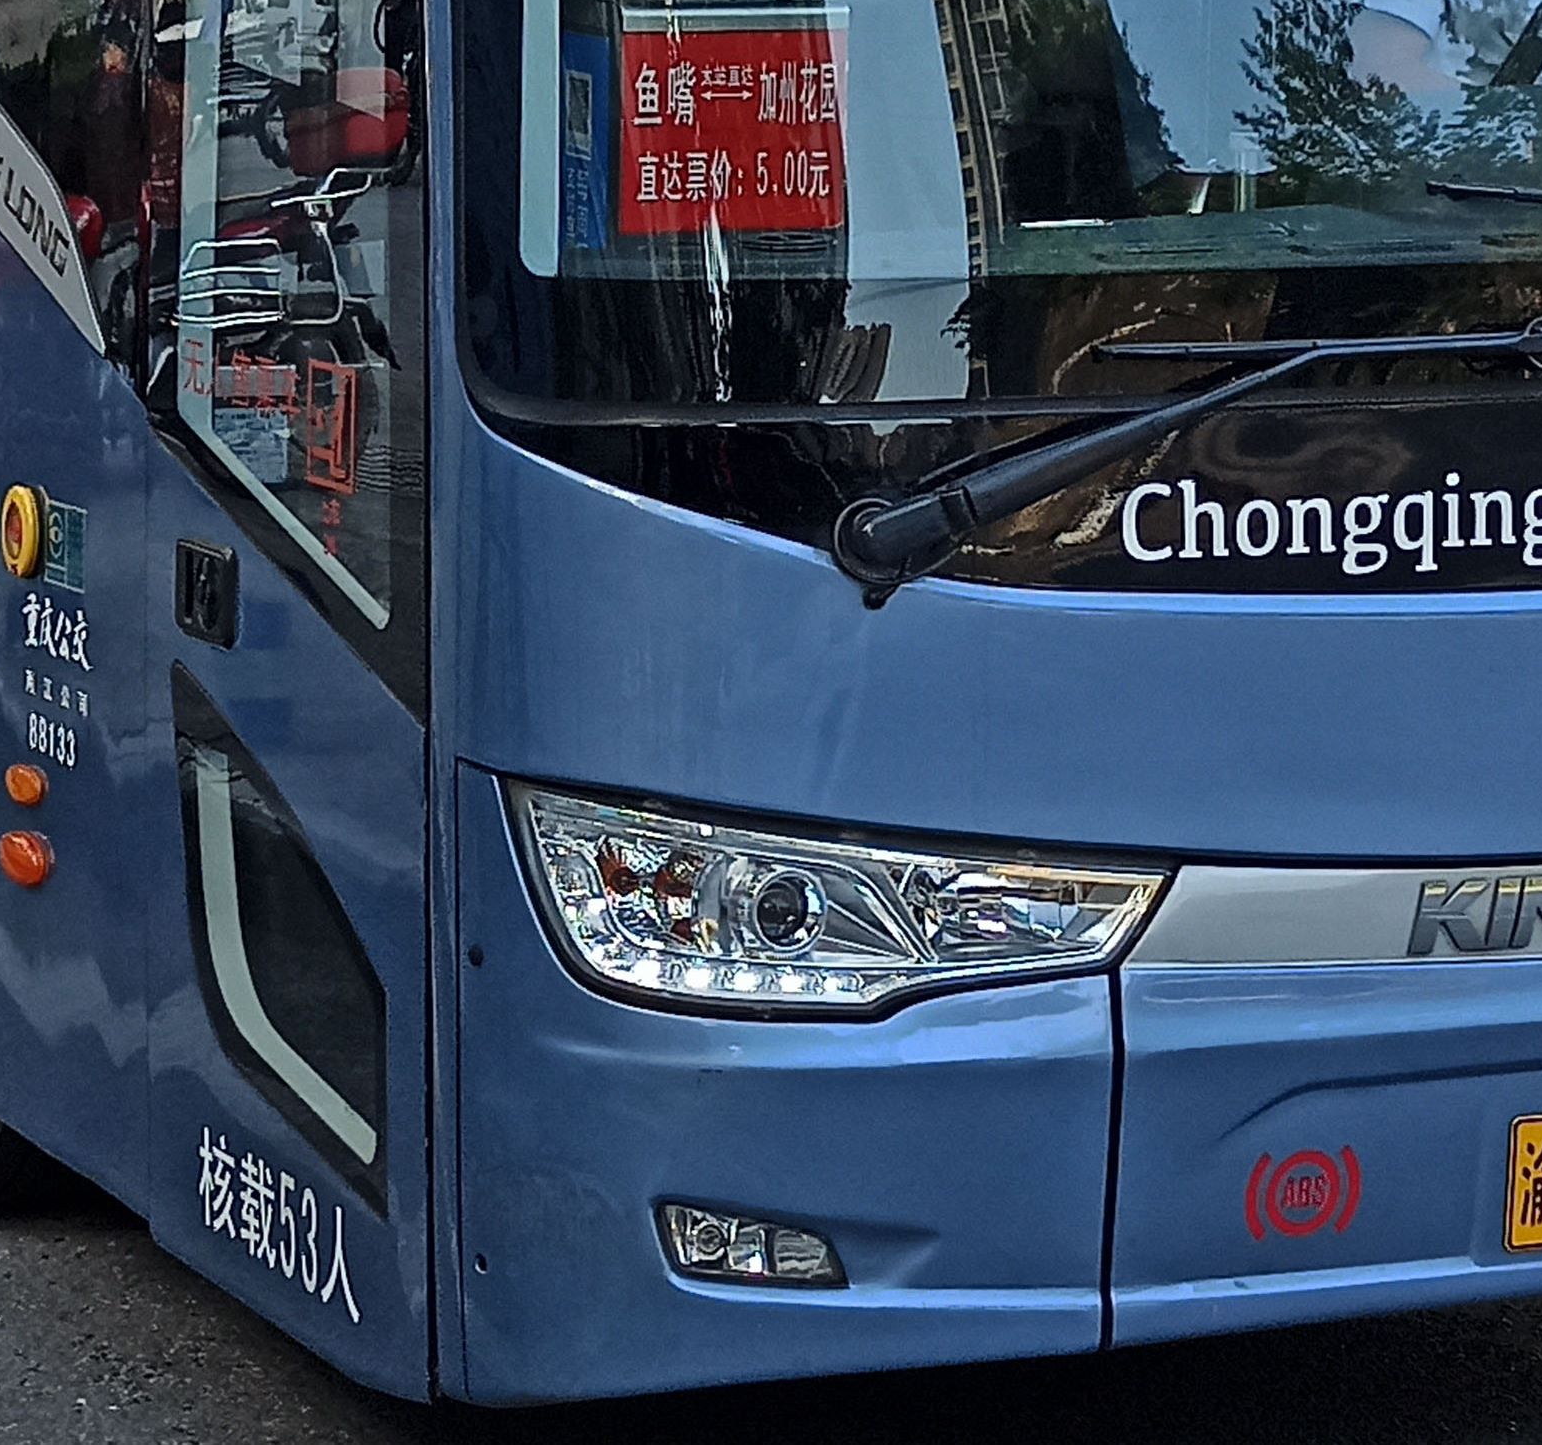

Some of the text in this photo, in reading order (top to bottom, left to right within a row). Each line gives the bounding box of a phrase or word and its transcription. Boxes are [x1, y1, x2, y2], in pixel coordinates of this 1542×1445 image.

[631, 60, 697, 126] 鱼嘴
[758, 58, 838, 126] 加州花园
[2, 167, 71, 278] LONG
[28, 712, 76, 767] 88133
[199, 1126, 360, 1323] 核载53人
[1281, 1175, 1329, 1209] ABS
